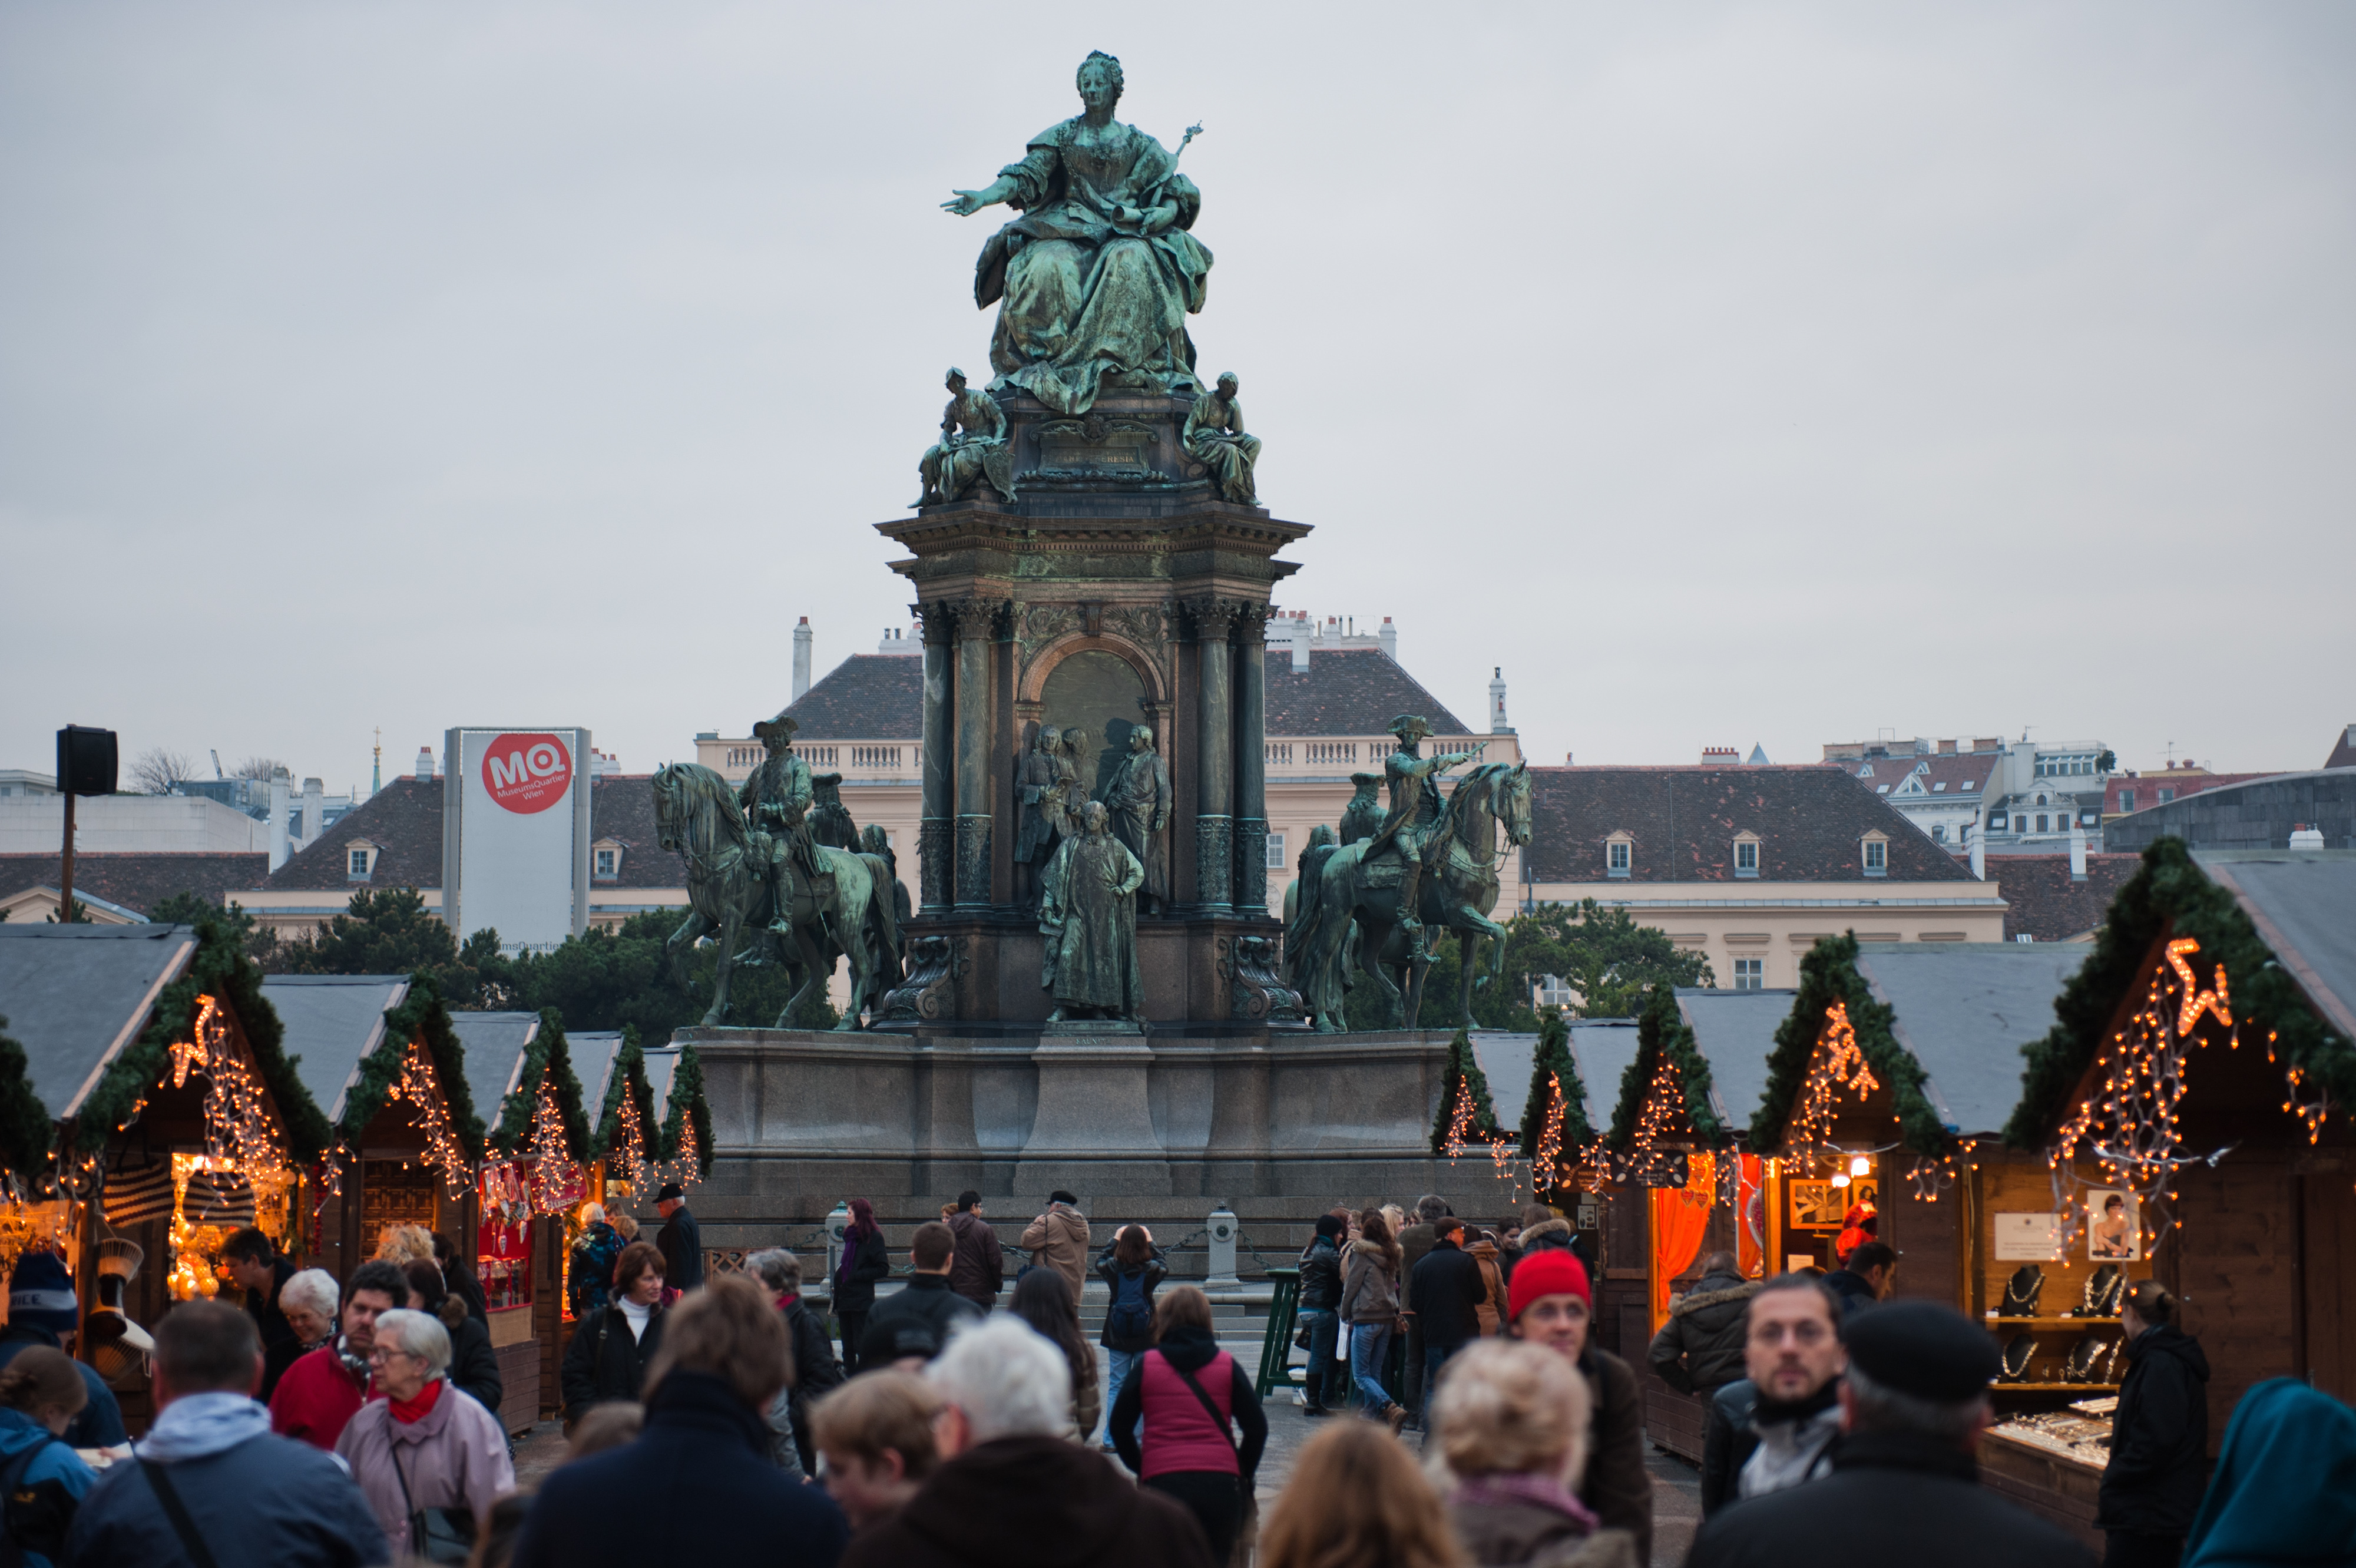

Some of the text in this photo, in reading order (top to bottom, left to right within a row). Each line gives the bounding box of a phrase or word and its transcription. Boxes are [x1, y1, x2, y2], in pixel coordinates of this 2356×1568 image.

[489, 743, 565, 789] MQ
[497, 774, 565, 798] MuseumsQuartier
[522, 789, 544, 800] Wien
[499, 941, 562, 951] msQuartie
